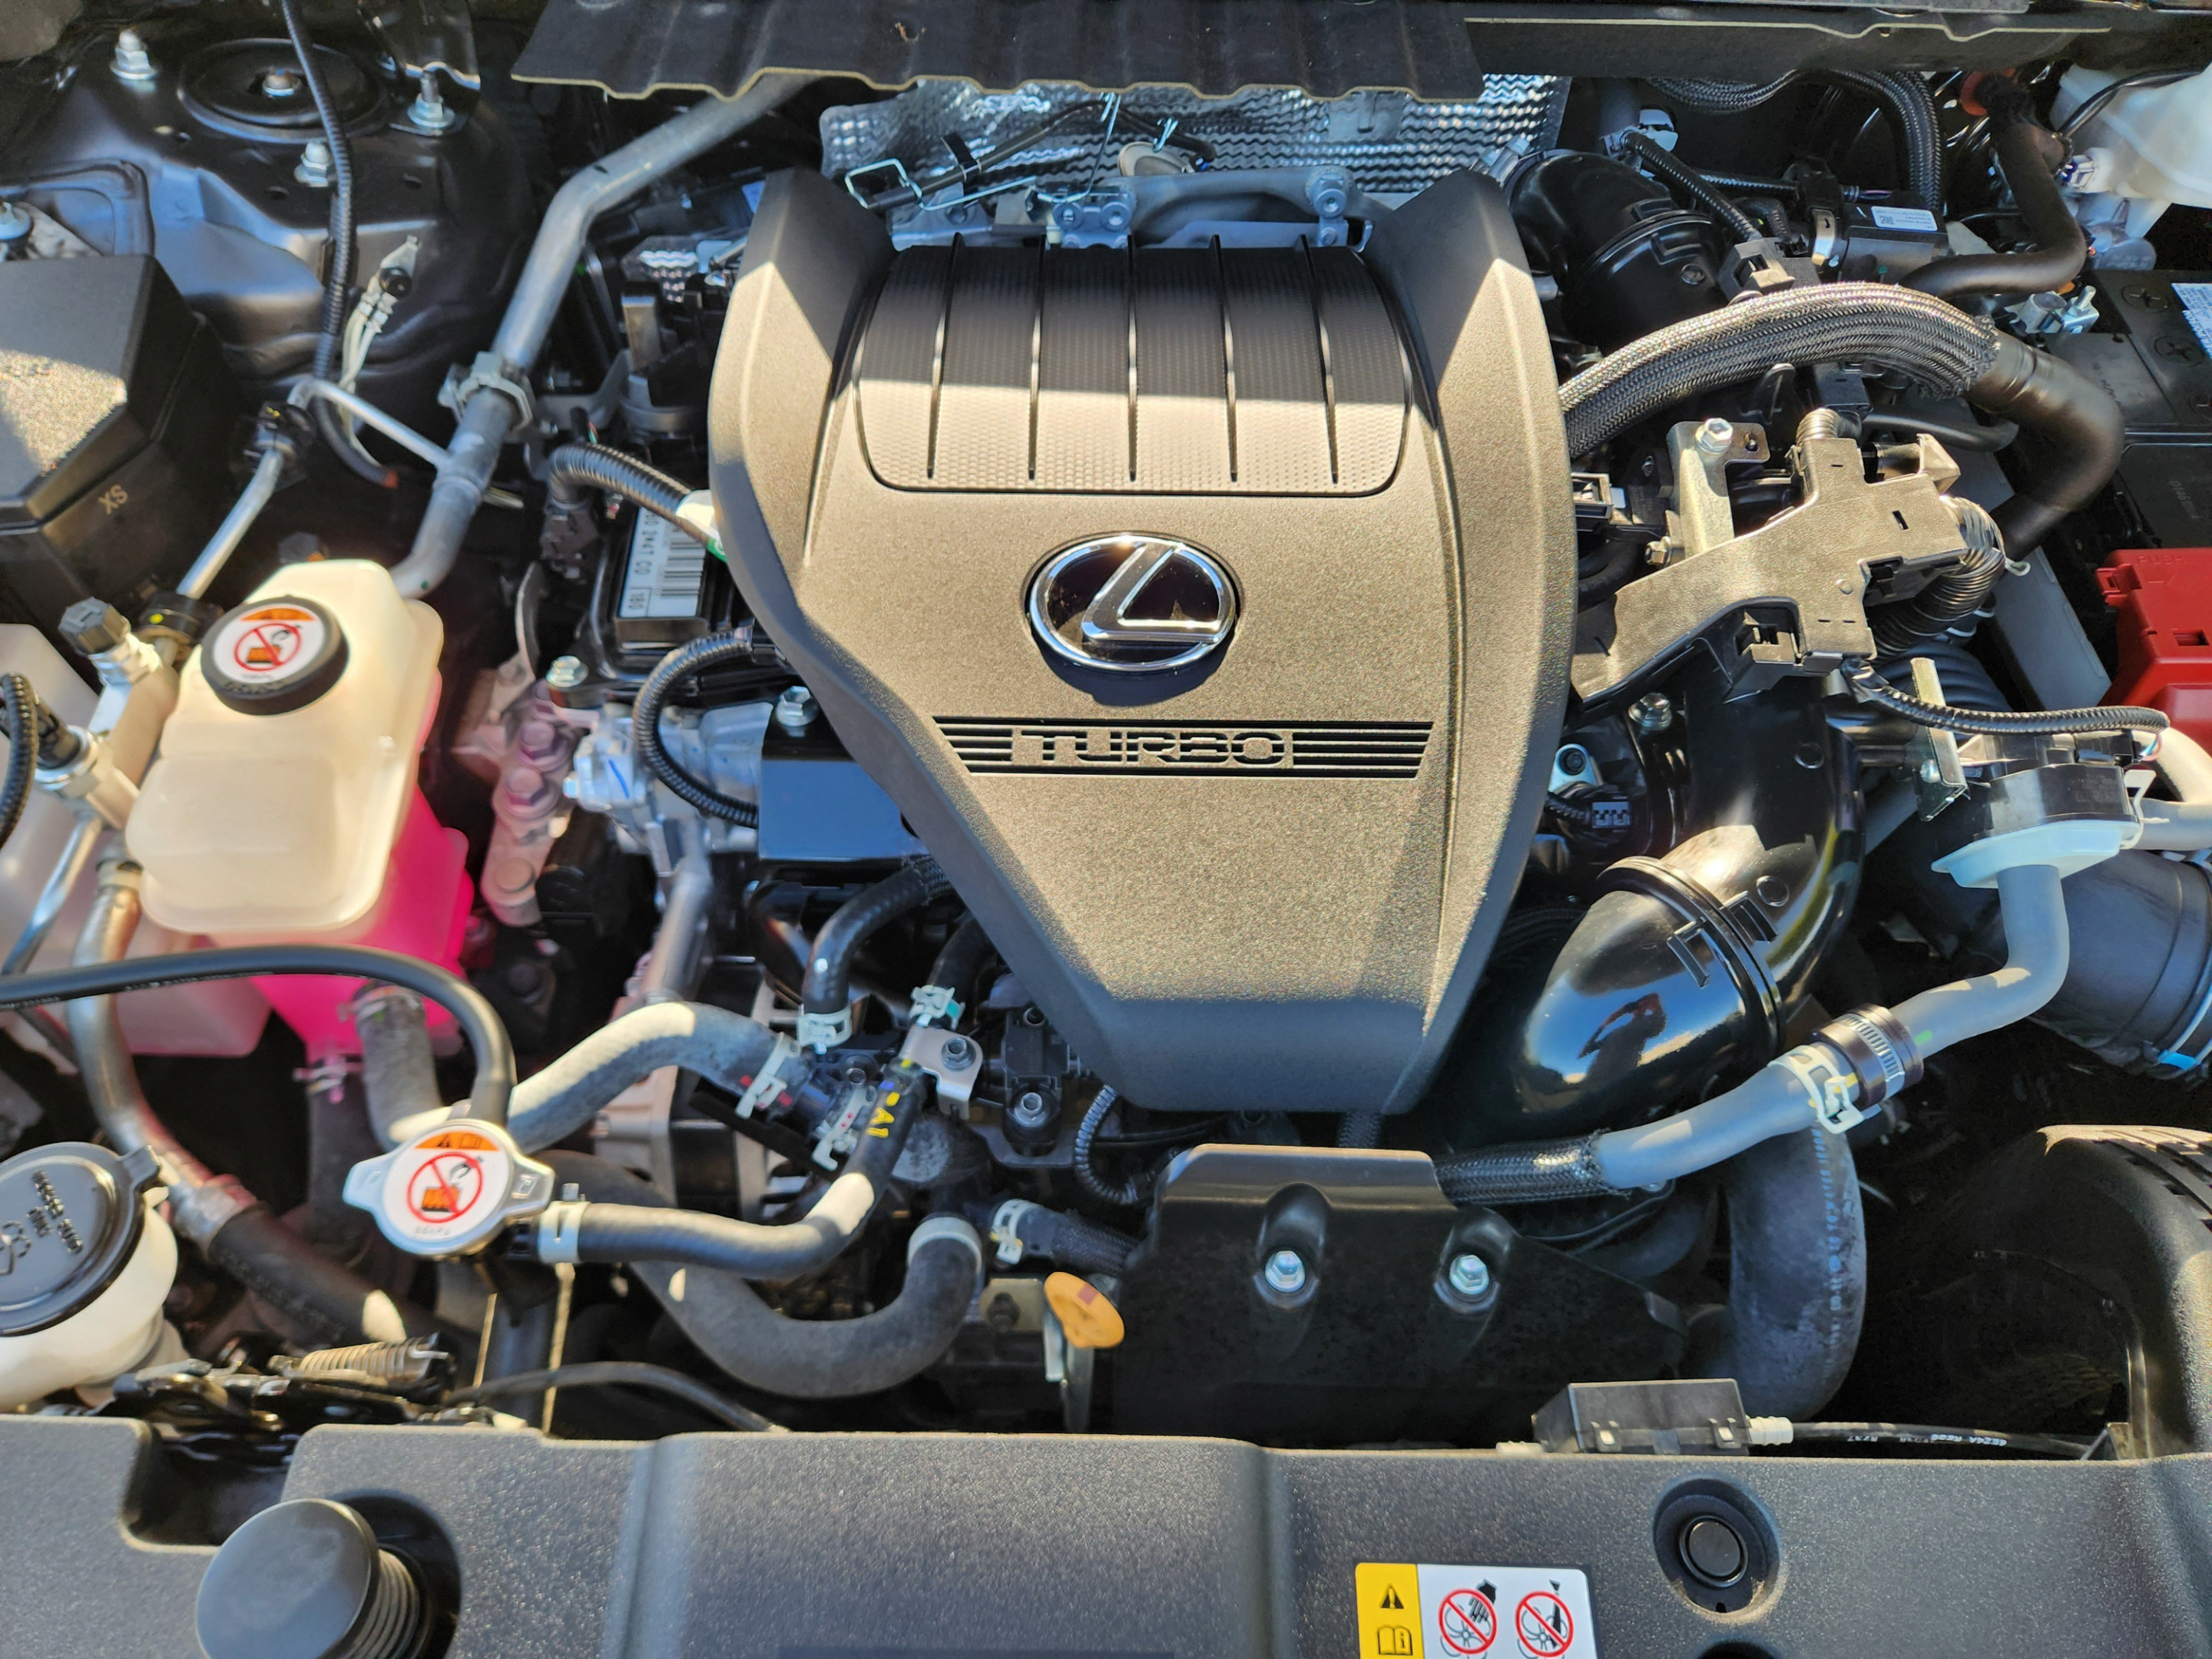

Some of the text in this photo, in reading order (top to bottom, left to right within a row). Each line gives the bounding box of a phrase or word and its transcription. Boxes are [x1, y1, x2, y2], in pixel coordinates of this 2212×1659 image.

[98, 484, 128, 515] XS
[2137, 555, 2187, 565] PUSH
[64, 602, 102, 628] H
[1020, 729, 1286, 766] TURBO
